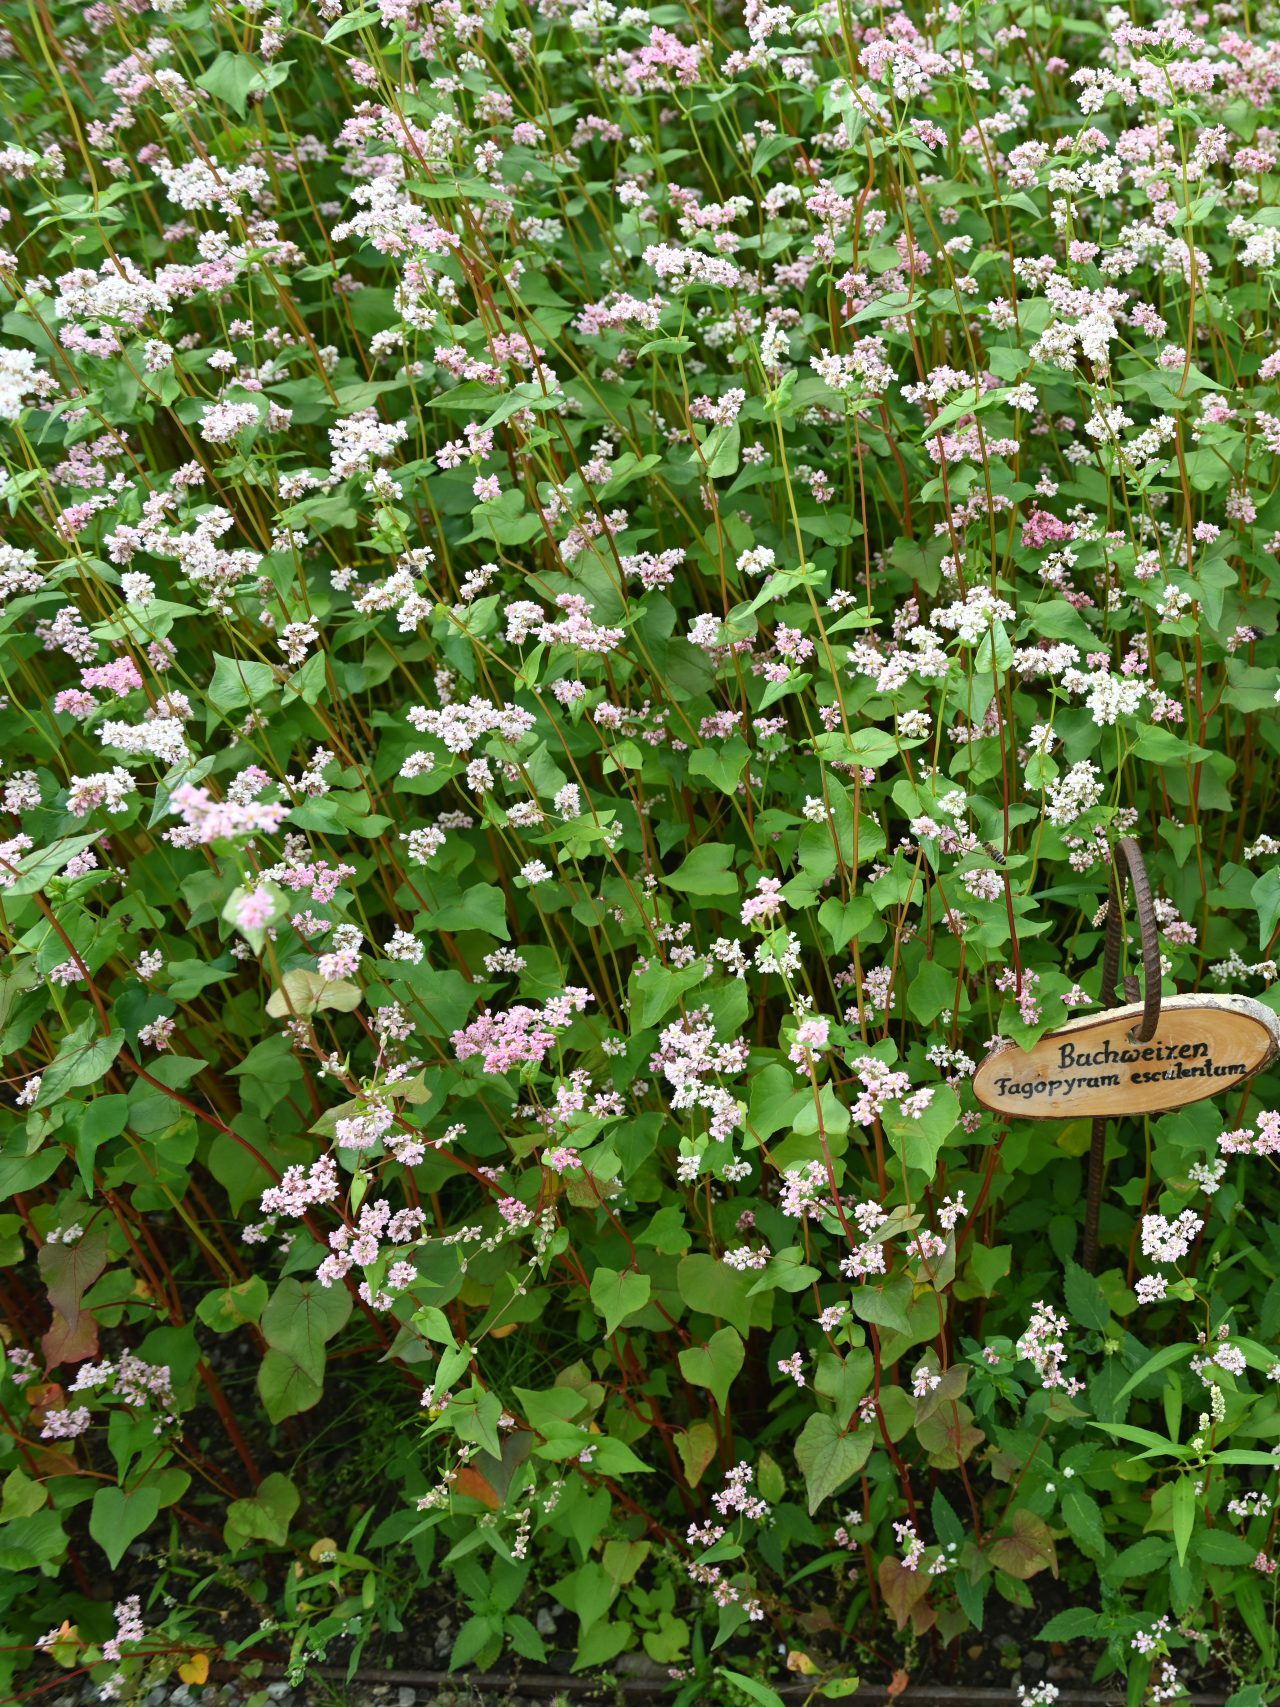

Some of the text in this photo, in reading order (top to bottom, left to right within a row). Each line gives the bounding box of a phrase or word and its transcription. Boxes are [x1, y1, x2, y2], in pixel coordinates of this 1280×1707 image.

[1057, 1039, 1209, 1069] Buchweizen
[994, 1058, 1248, 1099] Fagopyrum esculentum
